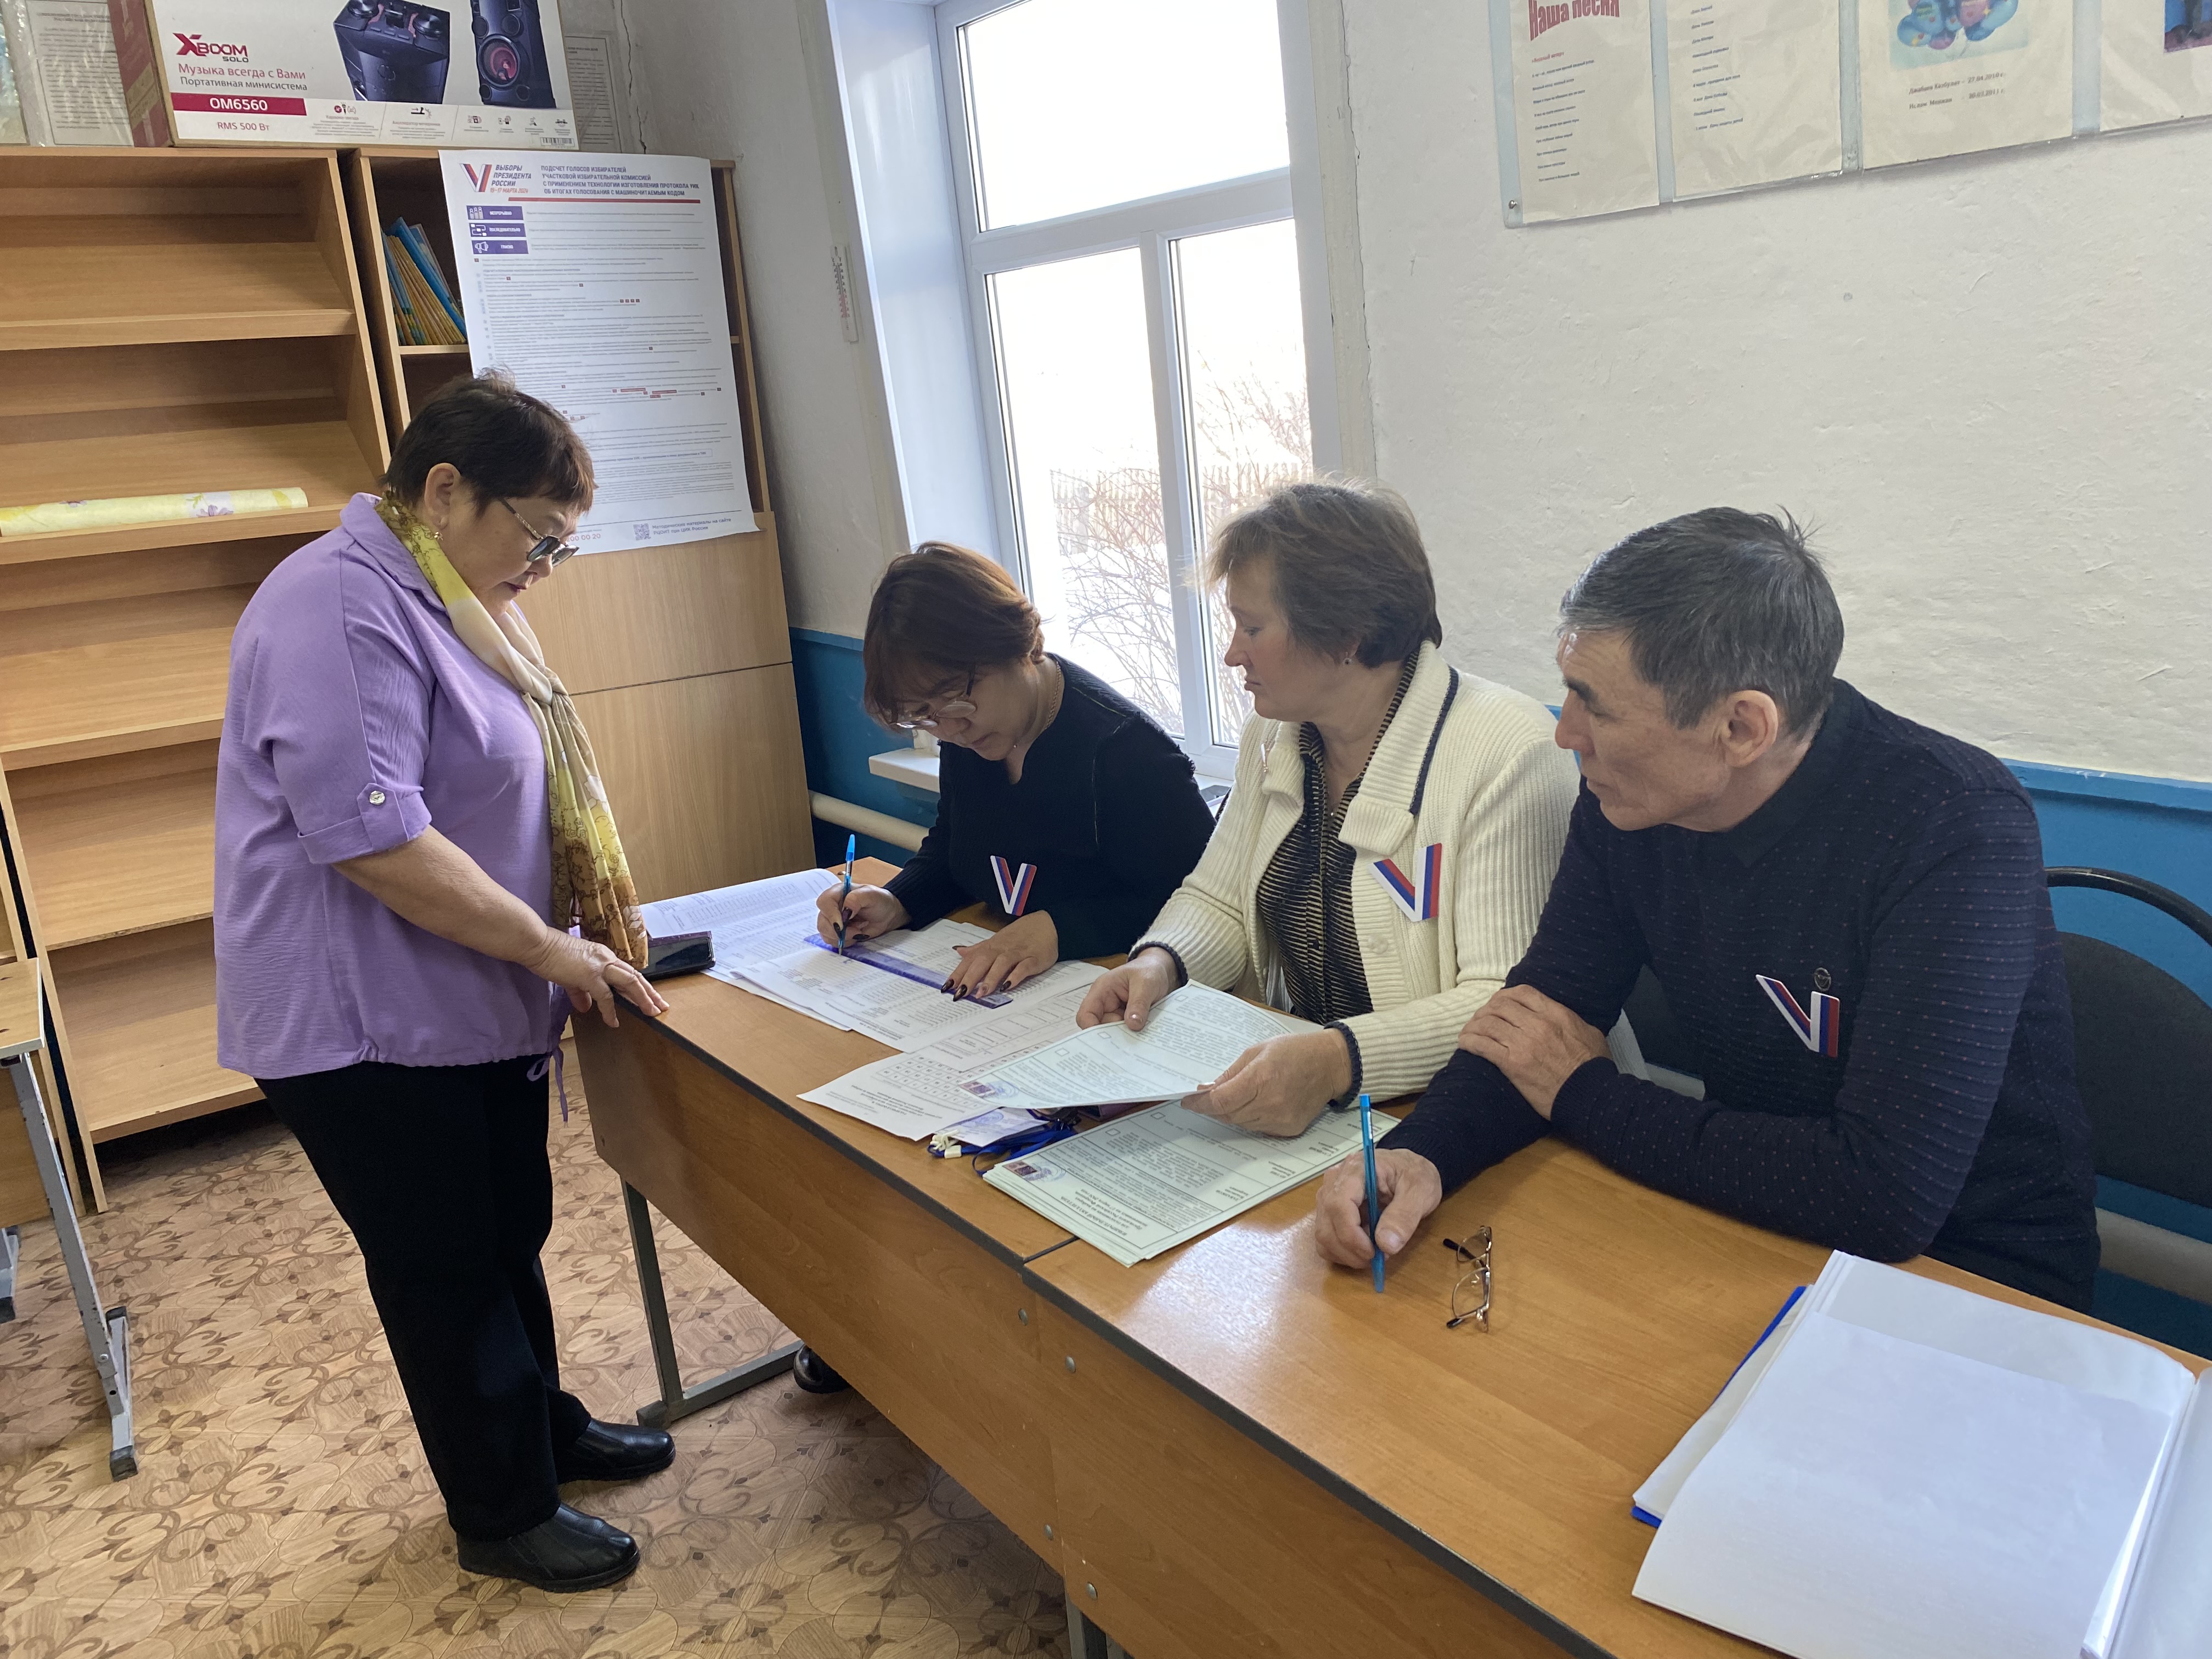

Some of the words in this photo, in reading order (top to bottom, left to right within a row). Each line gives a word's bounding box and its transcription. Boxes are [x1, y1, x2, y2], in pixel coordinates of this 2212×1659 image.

[1528, 0, 1570, 42] Наша
[172, 33, 248, 57] XBOOM
[178, 63, 224, 76] Музыка
[228, 67, 265, 79] всегда
[268, 69, 274, 78] с
[276, 69, 306, 80] Вами
[180, 76, 244, 87] Портативная
[245, 82, 308, 91] минисистема
[210, 97, 268, 111] OM6560
[217, 122, 238, 130] RMS
[240, 122, 257, 131] 500
[259, 123, 270, 131] Вт
